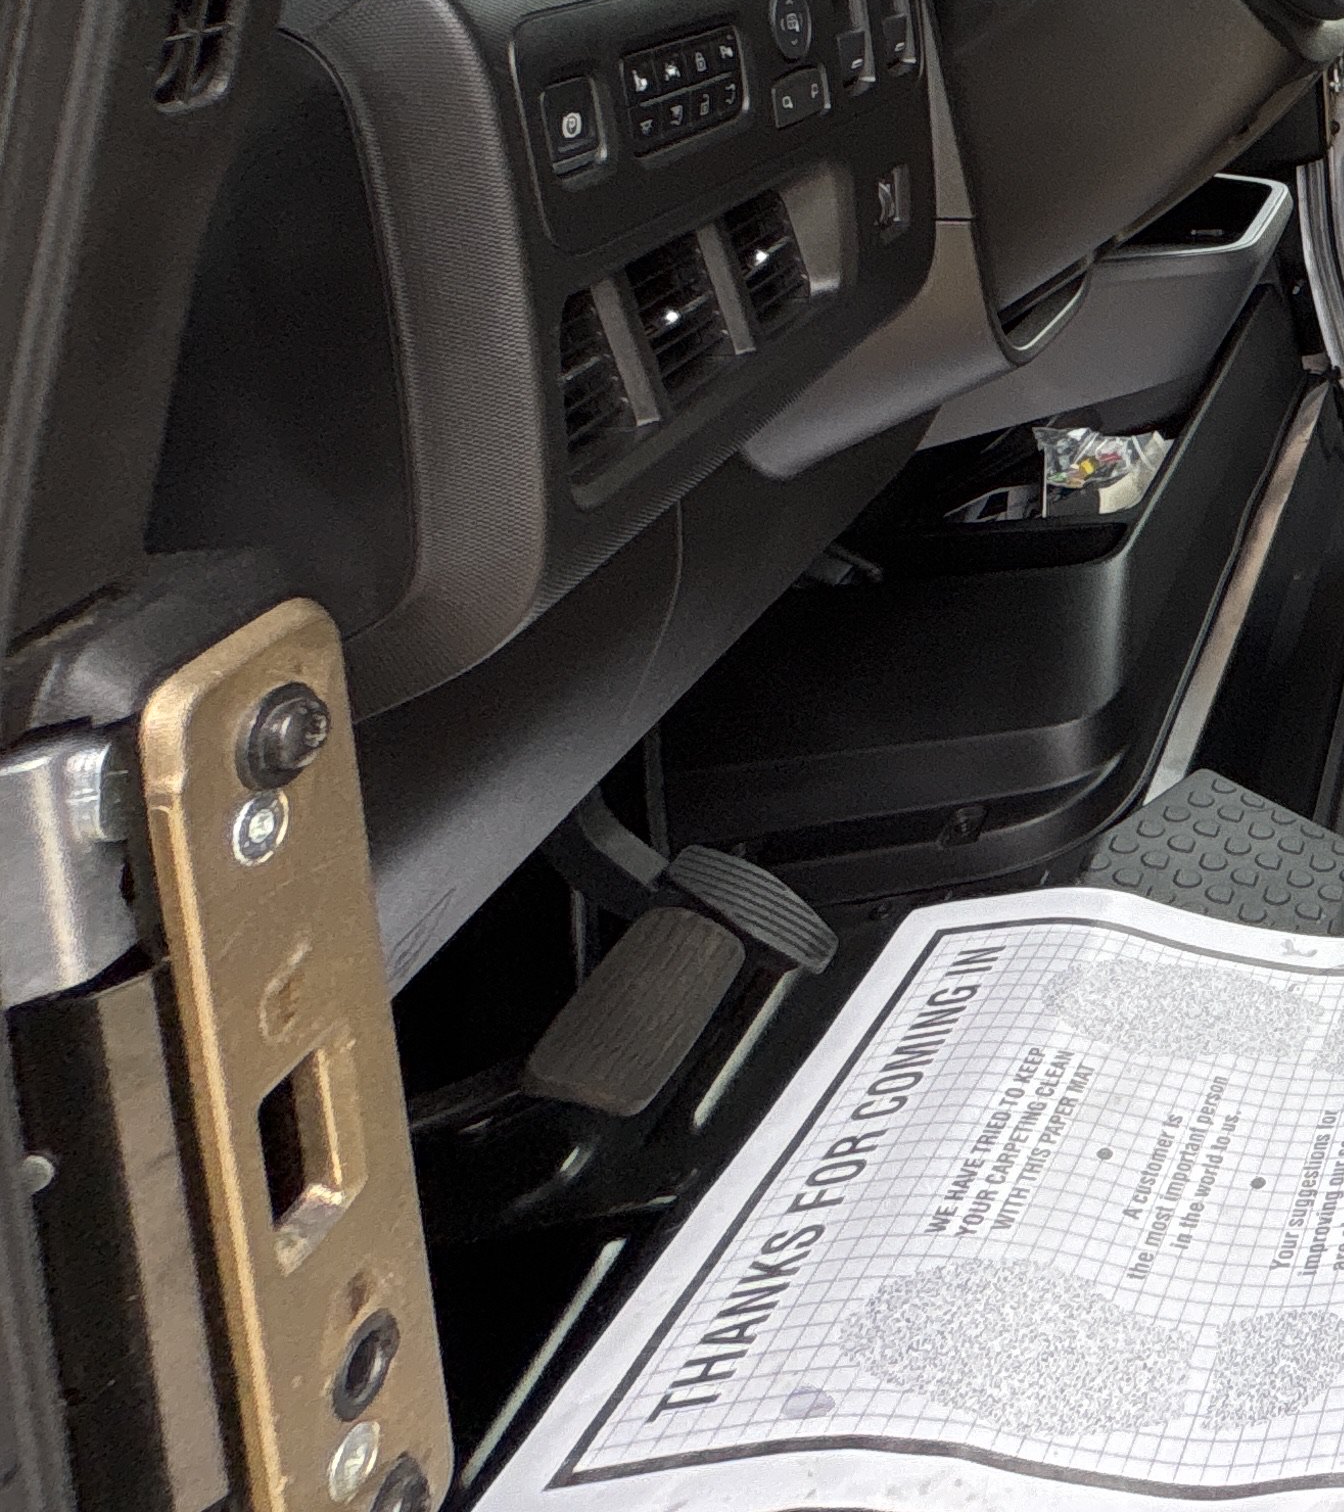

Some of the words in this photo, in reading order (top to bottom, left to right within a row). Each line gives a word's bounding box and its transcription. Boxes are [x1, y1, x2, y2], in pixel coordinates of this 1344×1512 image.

[924, 1205, 959, 1234] WE
[944, 1158, 985, 1201] HAVE
[970, 1111, 1011, 1154] TRIED
[998, 1087, 1025, 1106] TO
[1013, 1047, 1046, 1084] KEEP
[955, 1189, 999, 1237] YOUR
[985, 1100, 1048, 1185] CARPETING
[1035, 1050, 1075, 1098] CLEAN
[990, 1187, 1031, 1230] WITH
[1017, 1147, 1052, 1181] THIS
[1038, 1095, 1079, 1144] PAPER
[1065, 1062, 1095, 1094] MAT
[1122, 1206, 1143, 1220] A
[1133, 1128, 1175, 1204] customer
[1162, 1113, 1184, 1129] is
[1195, 1153, 1223, 1198] world
[1211, 1137, 1231, 1152] to
[1223, 1110, 1242, 1138] us.
[645, 1224, 825, 1423] THANKS
[785, 1128, 889, 1214] FOR
[850, 983, 982, 1121] COMING
[944, 945, 1007, 977] IN
[1127, 1251, 1154, 1281] the
[1145, 1205, 1173, 1247] most
[1159, 1126, 1207, 1202] important
[1197, 1075, 1229, 1126] person
[1178, 1201, 1205, 1229] the
[1269, 1231, 1299, 1271] Your
[1289, 1134, 1331, 1227] suggestions
[1316, 1109, 1339, 1130] for
[1169, 1232, 1193, 1250] in
[1297, 1190, 1344, 1276] improving
